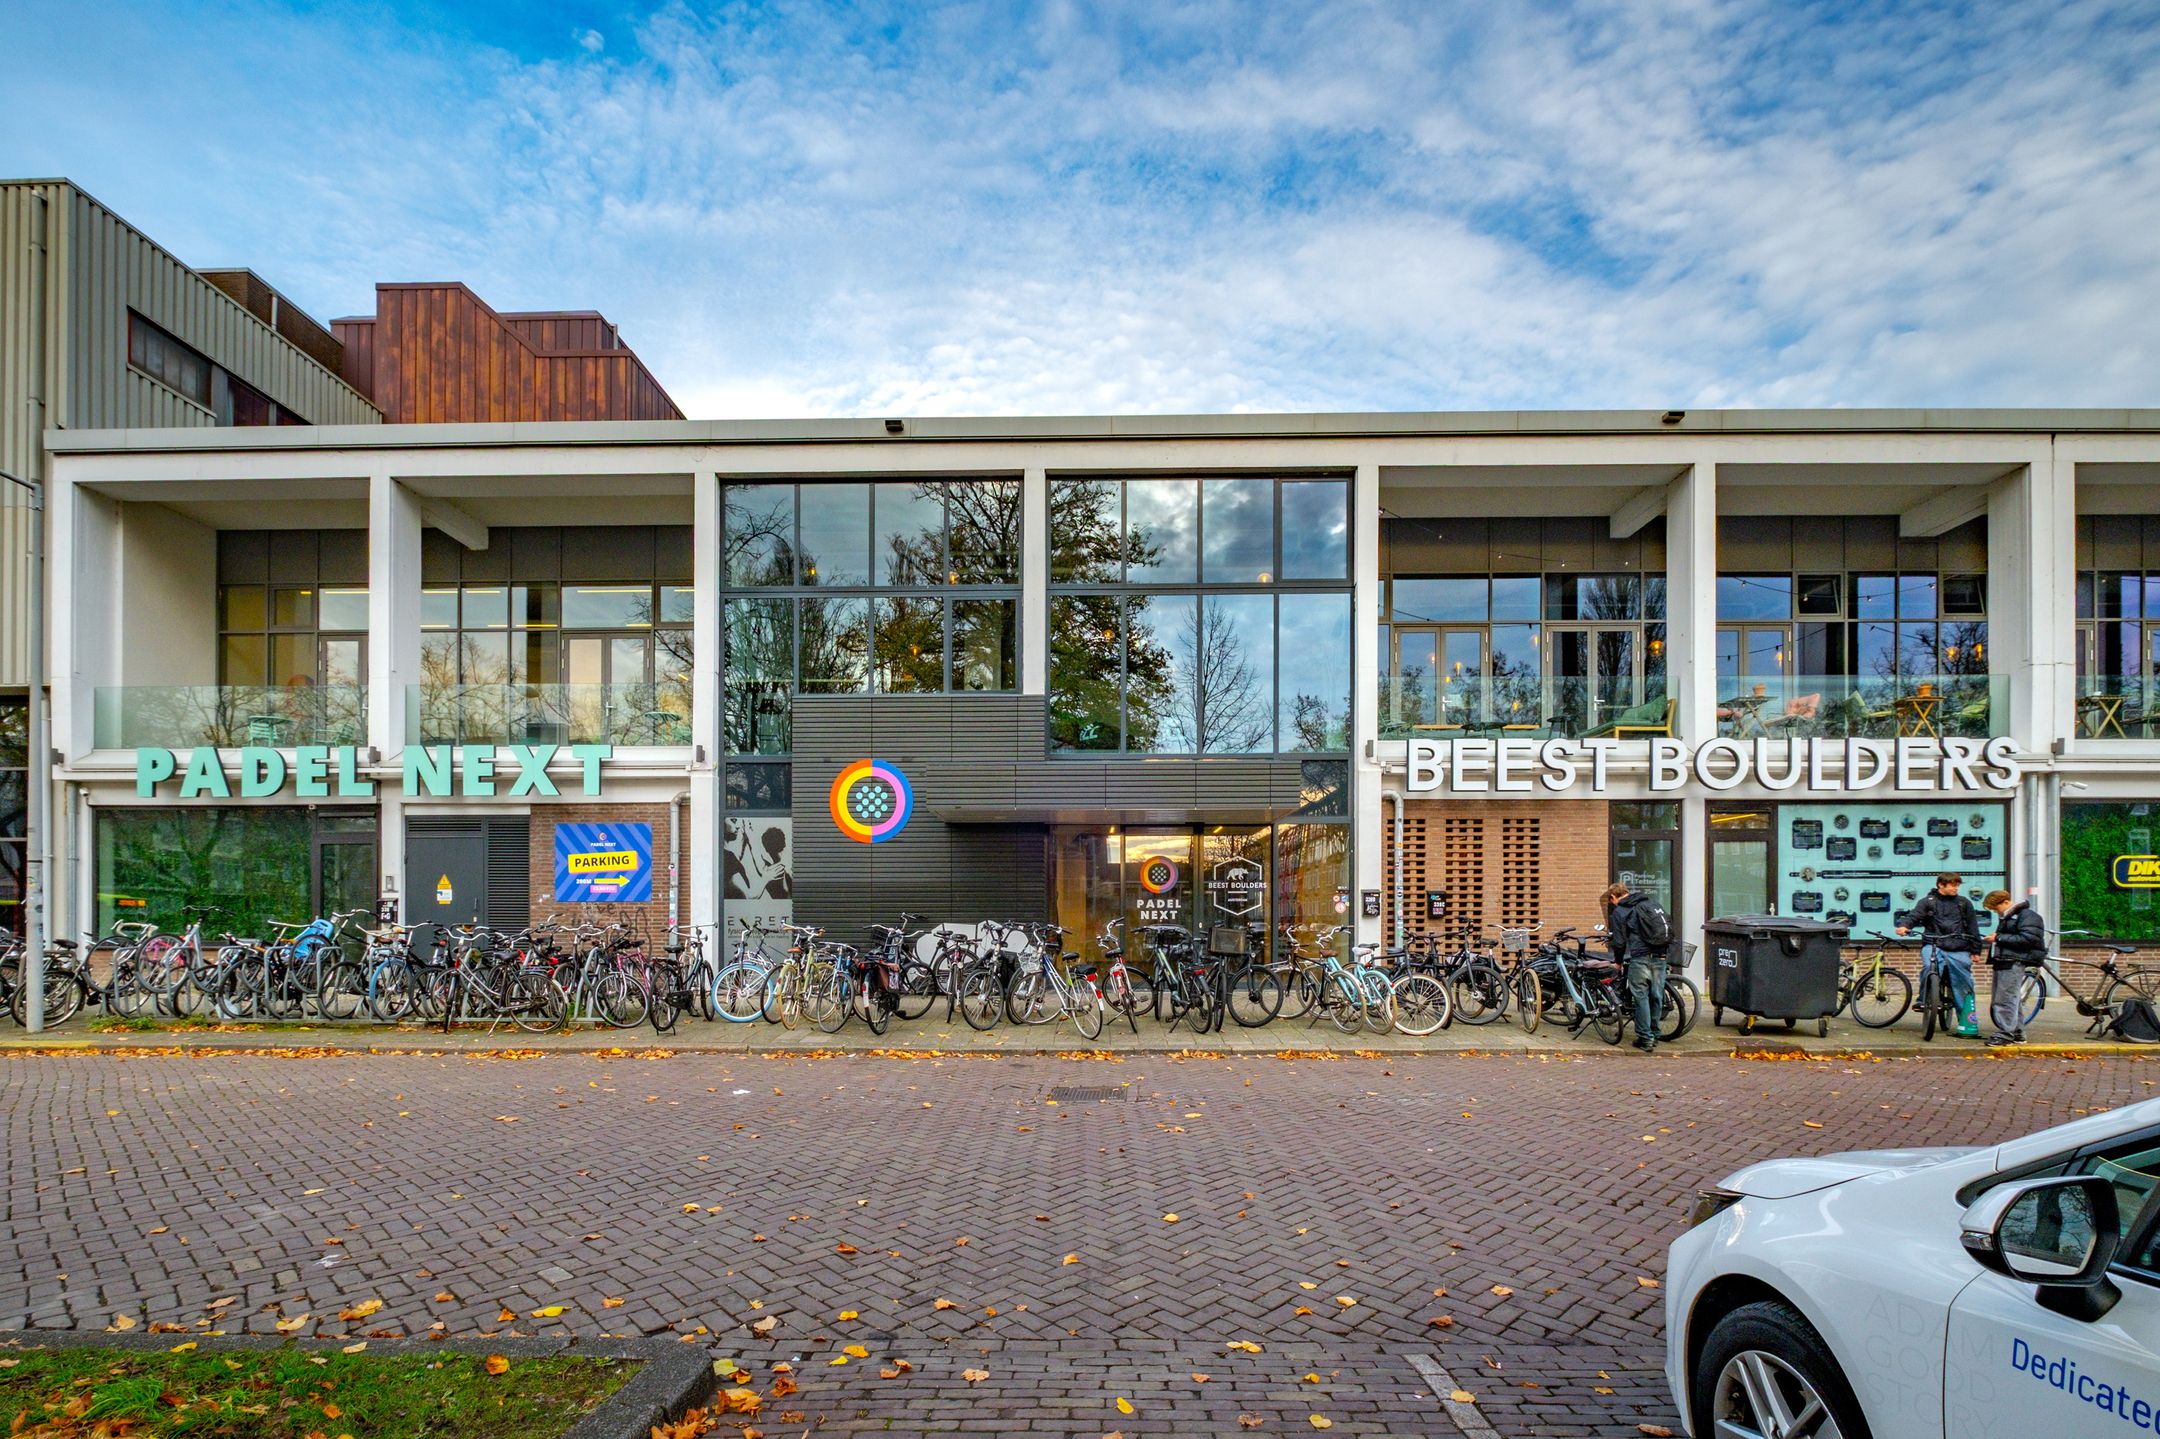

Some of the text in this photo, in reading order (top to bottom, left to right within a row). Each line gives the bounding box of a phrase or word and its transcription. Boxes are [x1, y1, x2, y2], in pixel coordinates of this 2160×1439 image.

[1406, 737, 2021, 792] BEEST BOULDERS
[137, 745, 612, 798] PADEL NEXT
[575, 855, 630, 867] PARKING
[1136, 899, 1181, 909] PADEL
[1140, 910, 1178, 920] NEXT
[727, 916, 789, 926] ERET
[1718, 948, 1729, 957] pre
[1719, 958, 1733, 968] zero
